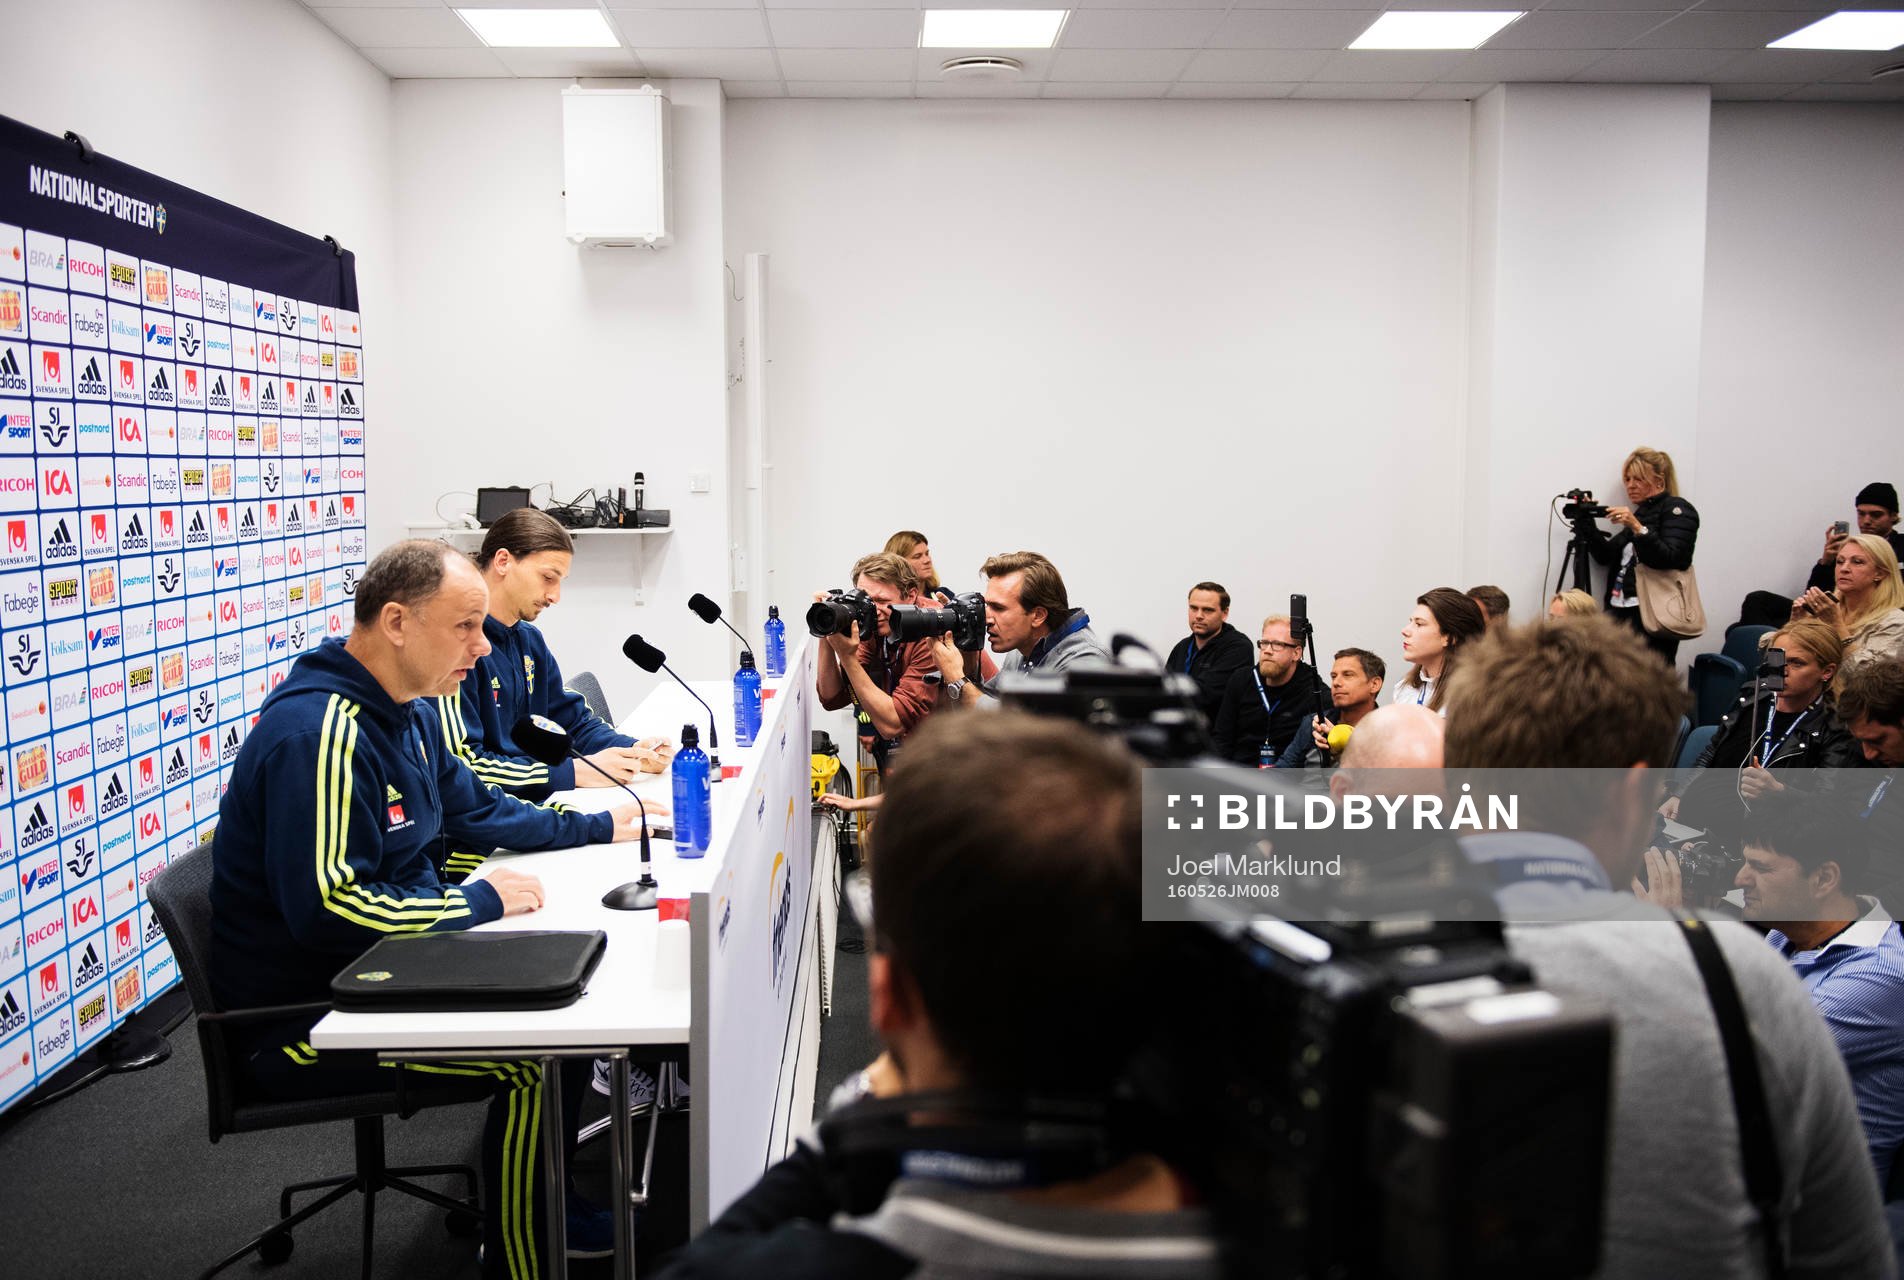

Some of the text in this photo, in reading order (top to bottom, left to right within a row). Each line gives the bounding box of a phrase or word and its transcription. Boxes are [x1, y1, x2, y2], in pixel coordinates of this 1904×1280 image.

[29, 165, 154, 229] NATIONALSPORTEN
[30, 250, 54, 269] BRA
[70, 259, 103, 278] RICOH
[111, 263, 136, 286] SPORT
[147, 284, 168, 296] GULD
[175, 284, 200, 301] Scandic
[205, 292, 227, 314] Fabege
[263, 304, 274, 312] INTER
[284, 301, 291, 314] SJ
[0, 306, 21, 321] ULD
[32, 306, 67, 325] Scandic
[264, 312, 275, 321] SPORT
[75, 313, 104, 337] Fabege
[112, 320, 140, 337] Folksam
[156, 325, 172, 335] INTER
[186, 323, 194, 338] SJ
[322, 314, 333, 333] ICA
[157, 335, 172, 347] SPORT
[207, 341, 230, 351] postnord
[261, 342, 277, 364] ICA
[0, 374, 26, 390] didas
[78, 381, 107, 395] adidas
[149, 390, 173, 402] adidas
[209, 396, 230, 407] adidas
[261, 401, 278, 411] adidas
[8, 415, 30, 426] INTER
[49, 407, 60, 426] SJ
[8, 427, 31, 438] SPORT
[79, 424, 109, 434] postnord
[119, 417, 142, 442] ICA
[209, 430, 232, 440] RICOH
[343, 430, 362, 438] INTER
[269, 463, 274, 476] SJ
[342, 470, 363, 478] COH
[45, 470, 72, 496] ICA
[118, 473, 146, 487] Scandic
[153, 474, 177, 493] Fabege
[187, 533, 208, 543] adidas
[240, 527, 258, 537] adidas
[46, 545, 77, 559] adidas
[85, 548, 104, 556] SVENSKA
[122, 537, 148, 550] adidas
[0, 557, 24, 566] SVENSKA
[225, 558, 237, 567] INTER
[264, 554, 284, 567] RICOH
[289, 547, 302, 566] ICA
[165, 558, 172, 573] SJ
[225, 567, 237, 576] SPORT
[123, 575, 150, 588] postnord
[345, 569, 354, 580] SJ
[50, 579, 77, 599] SPORT
[91, 581, 114, 600] GULD
[4, 593, 38, 613] Fabege
[243, 602, 264, 614] Scandic
[220, 601, 237, 623] ICA
[102, 625, 120, 637] INTER
[126, 624, 144, 640] BRA
[157, 617, 184, 632] RICOH
[295, 620, 300, 633] SJ
[329, 615, 341, 632] ICA
[18, 634, 30, 653] SJ
[51, 640, 83, 656] Folksam
[102, 635, 120, 648] SPORT
[276, 640, 286, 649] SPORT
[190, 656, 214, 671] Scandic
[219, 650, 240, 667] Fabege
[130, 666, 152, 688] SPORT
[163, 665, 183, 683] GULD
[92, 680, 124, 700] RICOH
[200, 690, 208, 705] SJ
[54, 694, 77, 712] BRA
[172, 704, 187, 716] INTER
[172, 714, 187, 726] SPORT
[131, 721, 157, 739] Folksam
[56, 742, 90, 765] Scandic
[97, 735, 124, 755] Fabege
[19, 760, 47, 783] GULD
[166, 766, 189, 784] adidas
[101, 794, 128, 814] adidas
[62, 814, 95, 833] SVENSKA SPEL
[140, 811, 161, 840] ICA
[21, 825, 54, 848] adidas
[102, 829, 131, 853] postnord
[0, 850, 12, 860] SPEL
[75, 838, 85, 857] SJ
[37, 859, 58, 876] INTER
[38, 871, 58, 889] SPORT
[73, 895, 98, 928] ICA
[27, 918, 64, 949] RICOH
[110, 947, 139, 968] SVENSKA SPEL
[75, 961, 104, 988] adidas
[148, 953, 173, 980] postnord
[117, 978, 139, 1007] GULD
[34, 992, 68, 1016] SVENSKA SPEL
[79, 994, 105, 1026] SPORT
[0, 1011, 25, 1037] didas
[39, 1028, 70, 1059] Fabege
